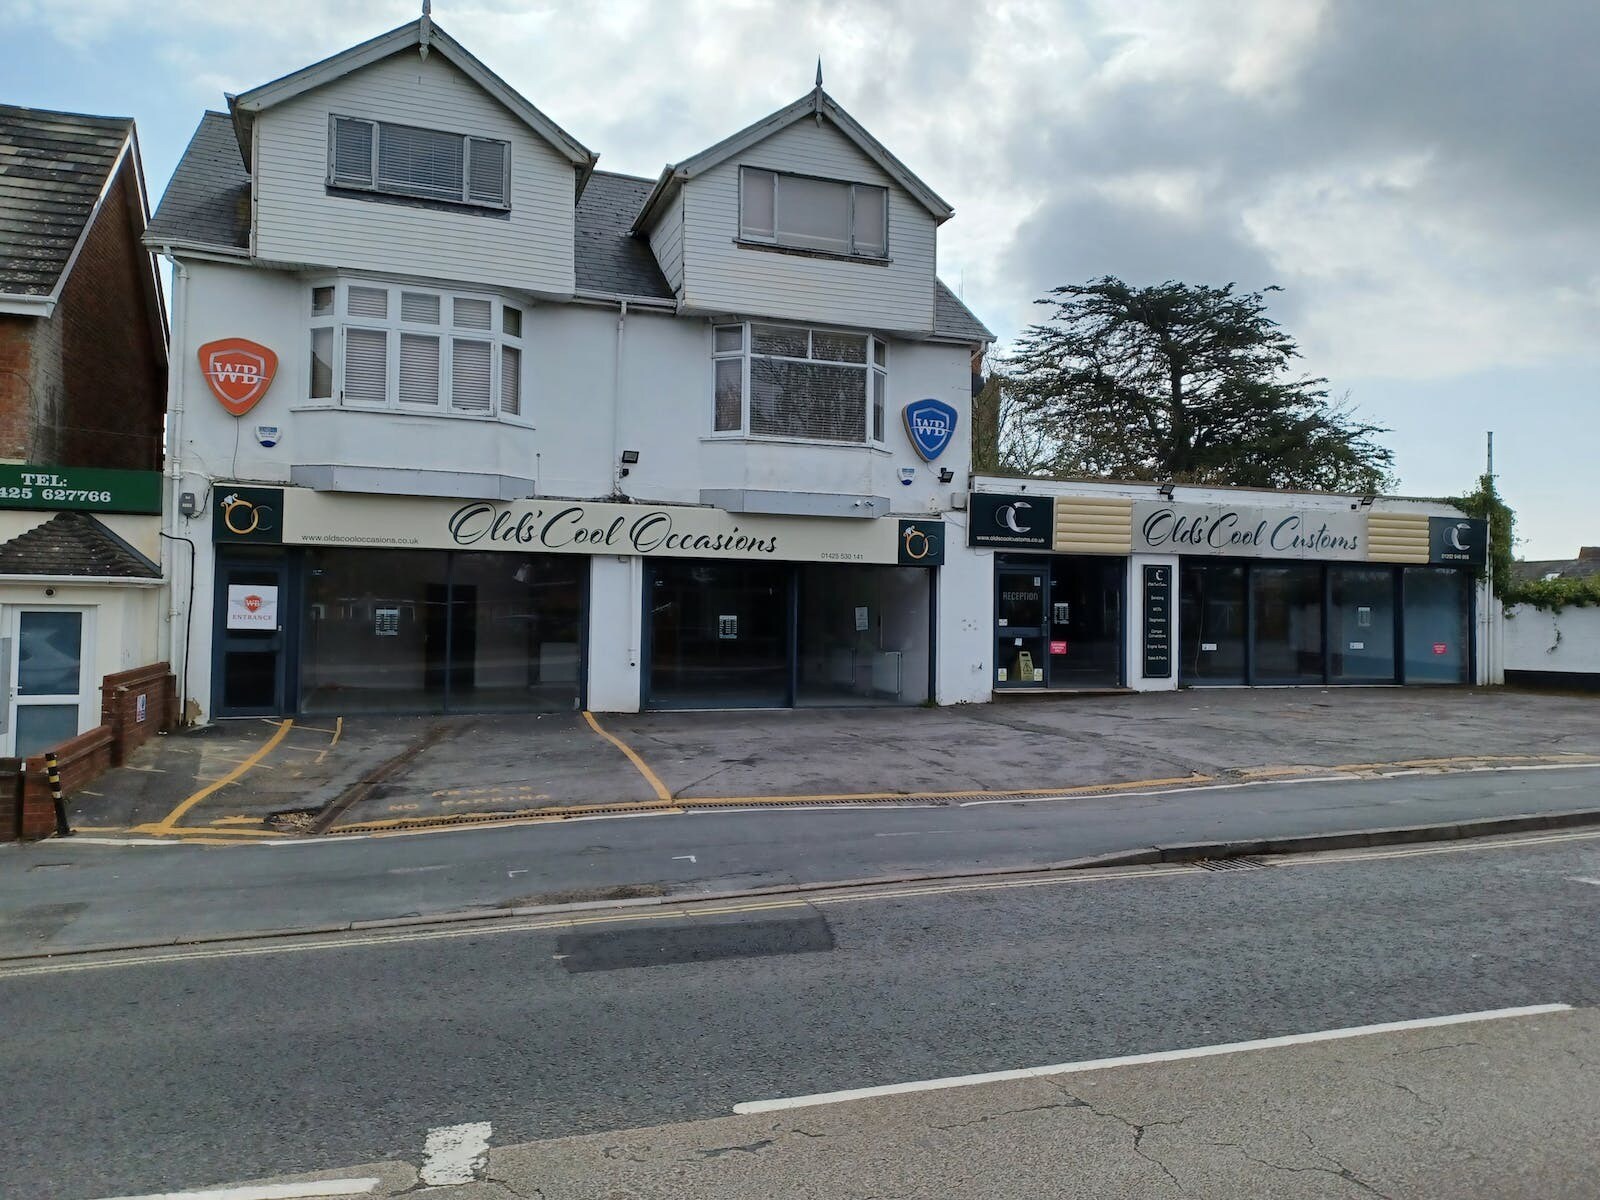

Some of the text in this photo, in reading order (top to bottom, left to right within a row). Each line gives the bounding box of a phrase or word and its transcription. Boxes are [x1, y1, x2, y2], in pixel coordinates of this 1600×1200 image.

[214, 362, 259, 385] WB
[915, 418, 946, 437] WB
[20, 473, 68, 487] TEL:
[41, 488, 112, 503] 627766
[301, 534, 419, 545] www.oldscooloccasions.co.uk
[629, 511, 777, 553] Occasions
[1270, 516, 1358, 552] Customs
[1002, 592, 1039, 601] RECEPTION
